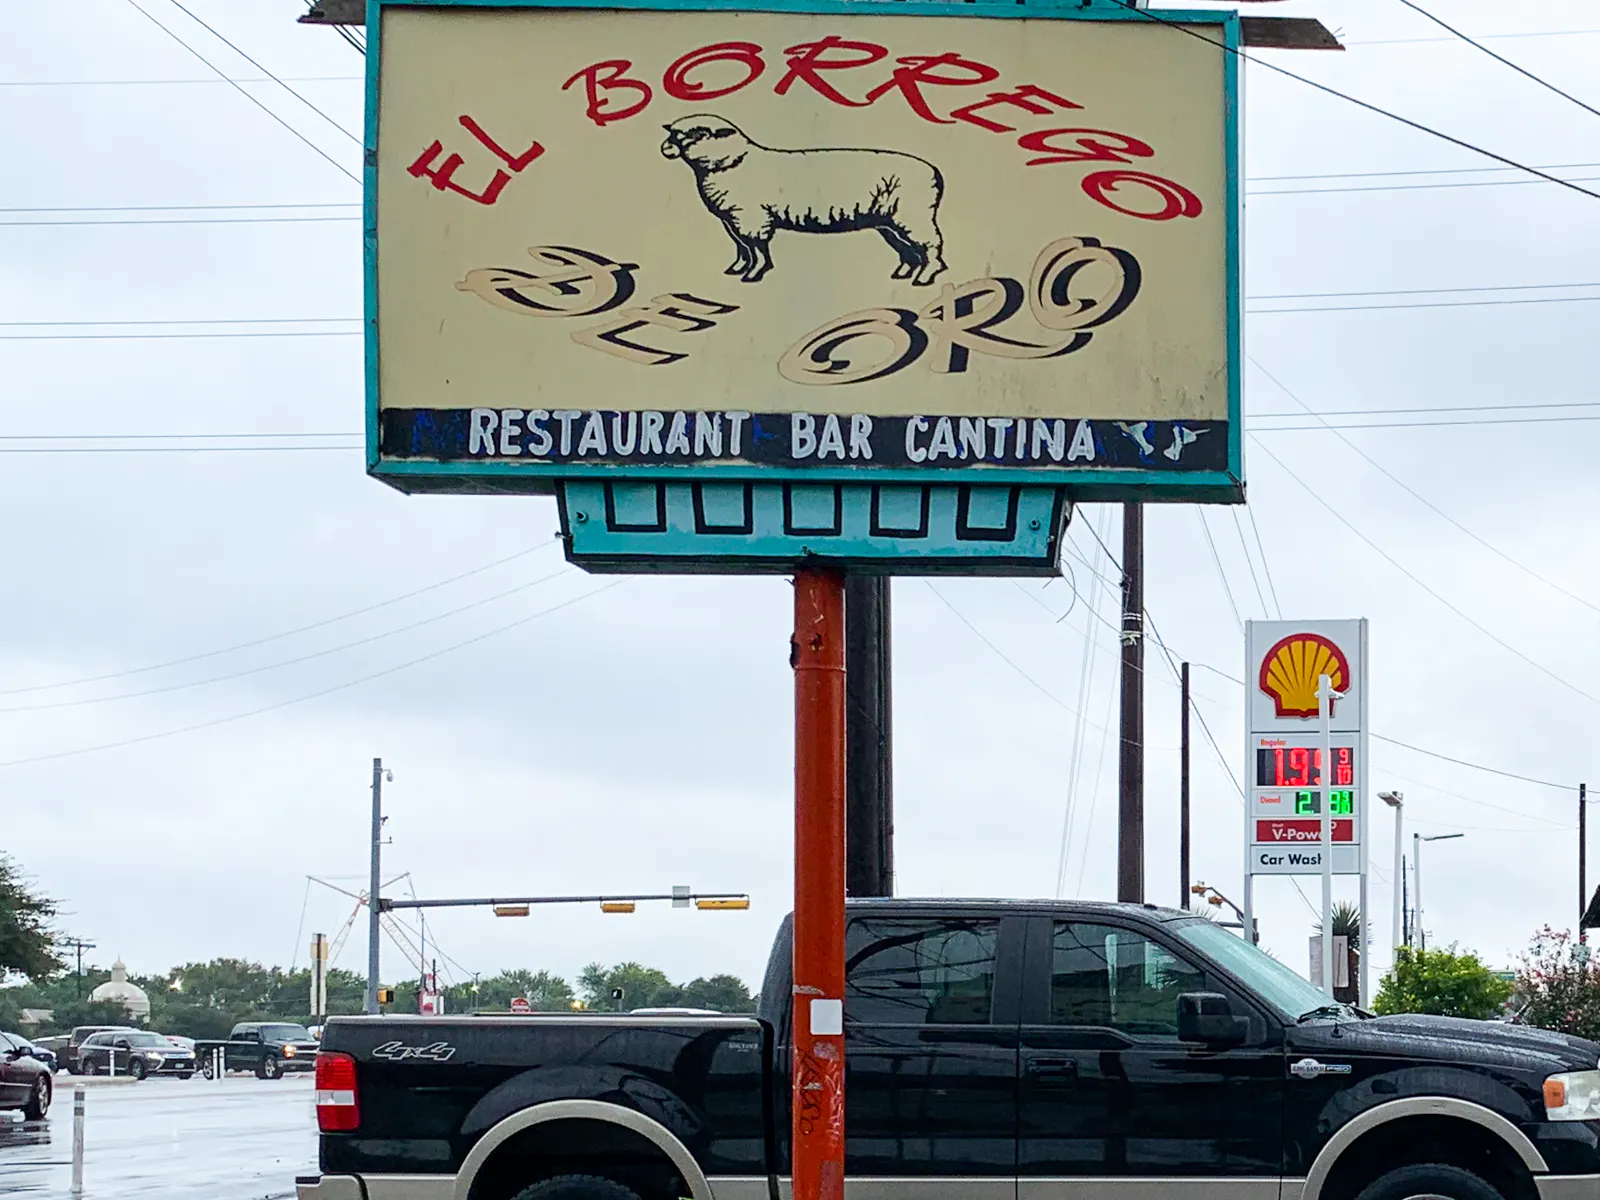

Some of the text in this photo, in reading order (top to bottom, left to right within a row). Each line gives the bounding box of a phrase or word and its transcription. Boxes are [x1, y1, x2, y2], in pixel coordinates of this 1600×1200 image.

[405, 35, 1203, 221] EL BORREGO
[454, 236, 1143, 386] DE ORO
[467, 407, 750, 457] RESTAURANT
[790, 411, 874, 461] BAR
[905, 414, 1097, 464] CANTINA
[1260, 853, 1284, 865] Car
[372, 1041, 456, 1061] 4x4
